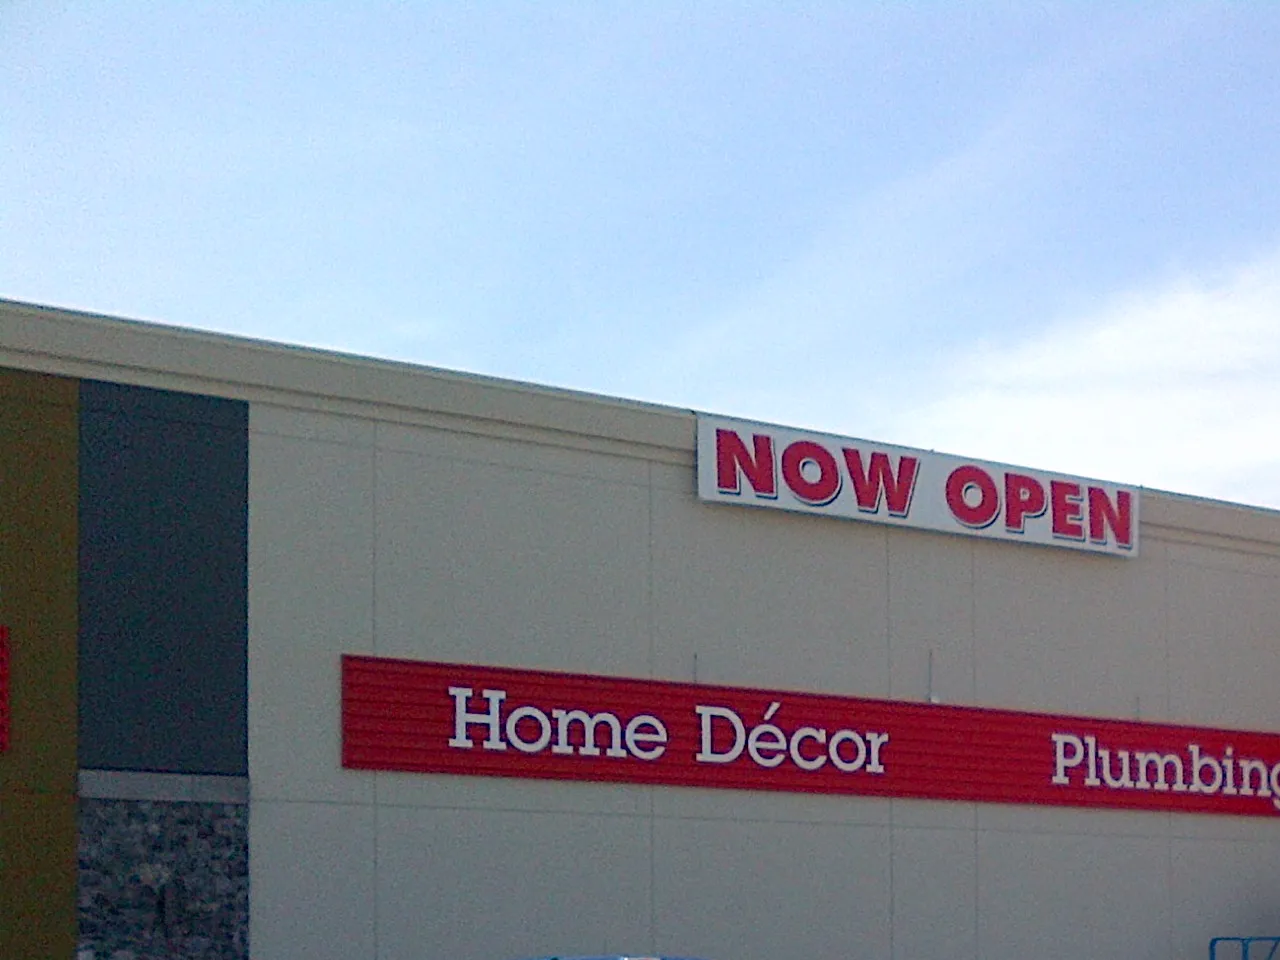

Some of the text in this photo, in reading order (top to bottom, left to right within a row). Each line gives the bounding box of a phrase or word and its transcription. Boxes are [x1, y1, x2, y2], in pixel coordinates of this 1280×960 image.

[715, 428, 1133, 549] NOW OPEN
[448, 686, 889, 774] Home Décor
